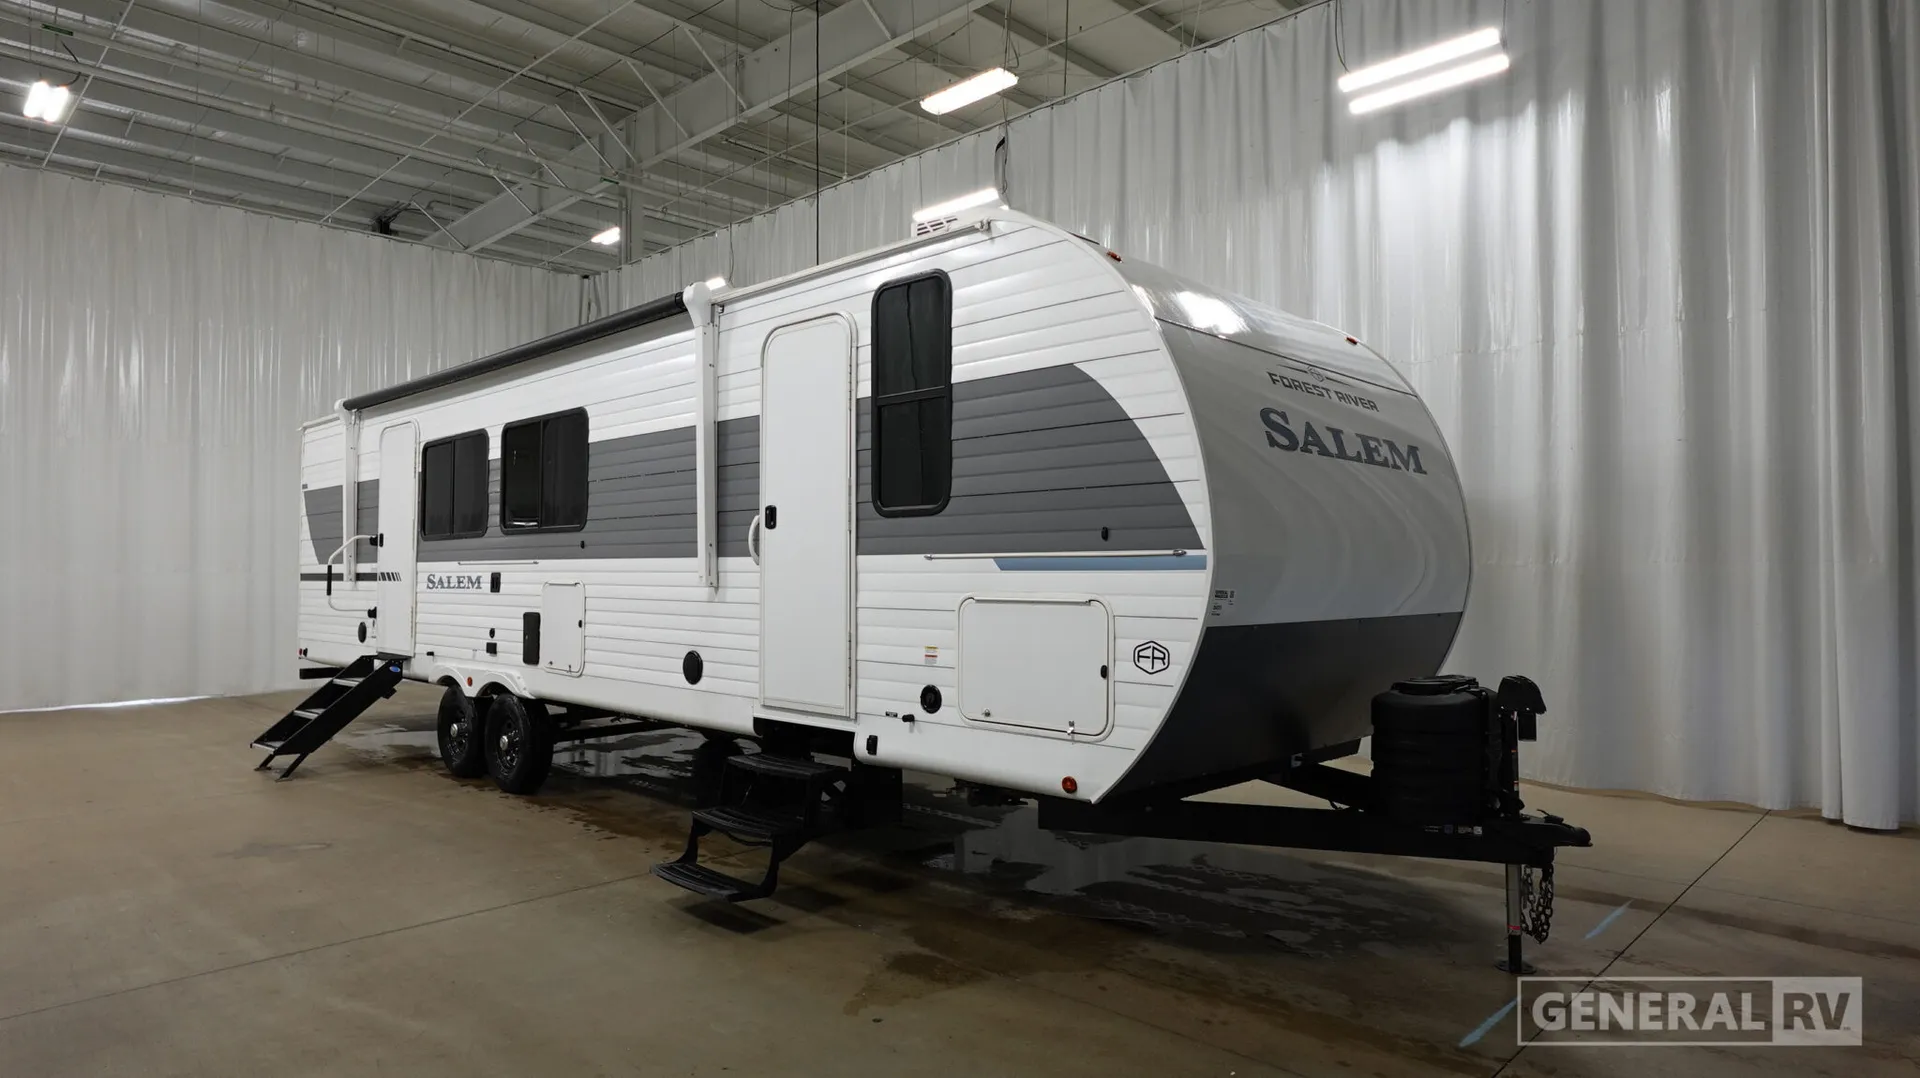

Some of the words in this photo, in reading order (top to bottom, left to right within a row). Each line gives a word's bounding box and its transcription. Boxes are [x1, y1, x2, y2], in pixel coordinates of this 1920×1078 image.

[1266, 371, 1333, 399] FOREST
[1335, 390, 1380, 412] RIVER
[1259, 407, 1428, 475] SALEM
[426, 573, 483, 590] SALEM
